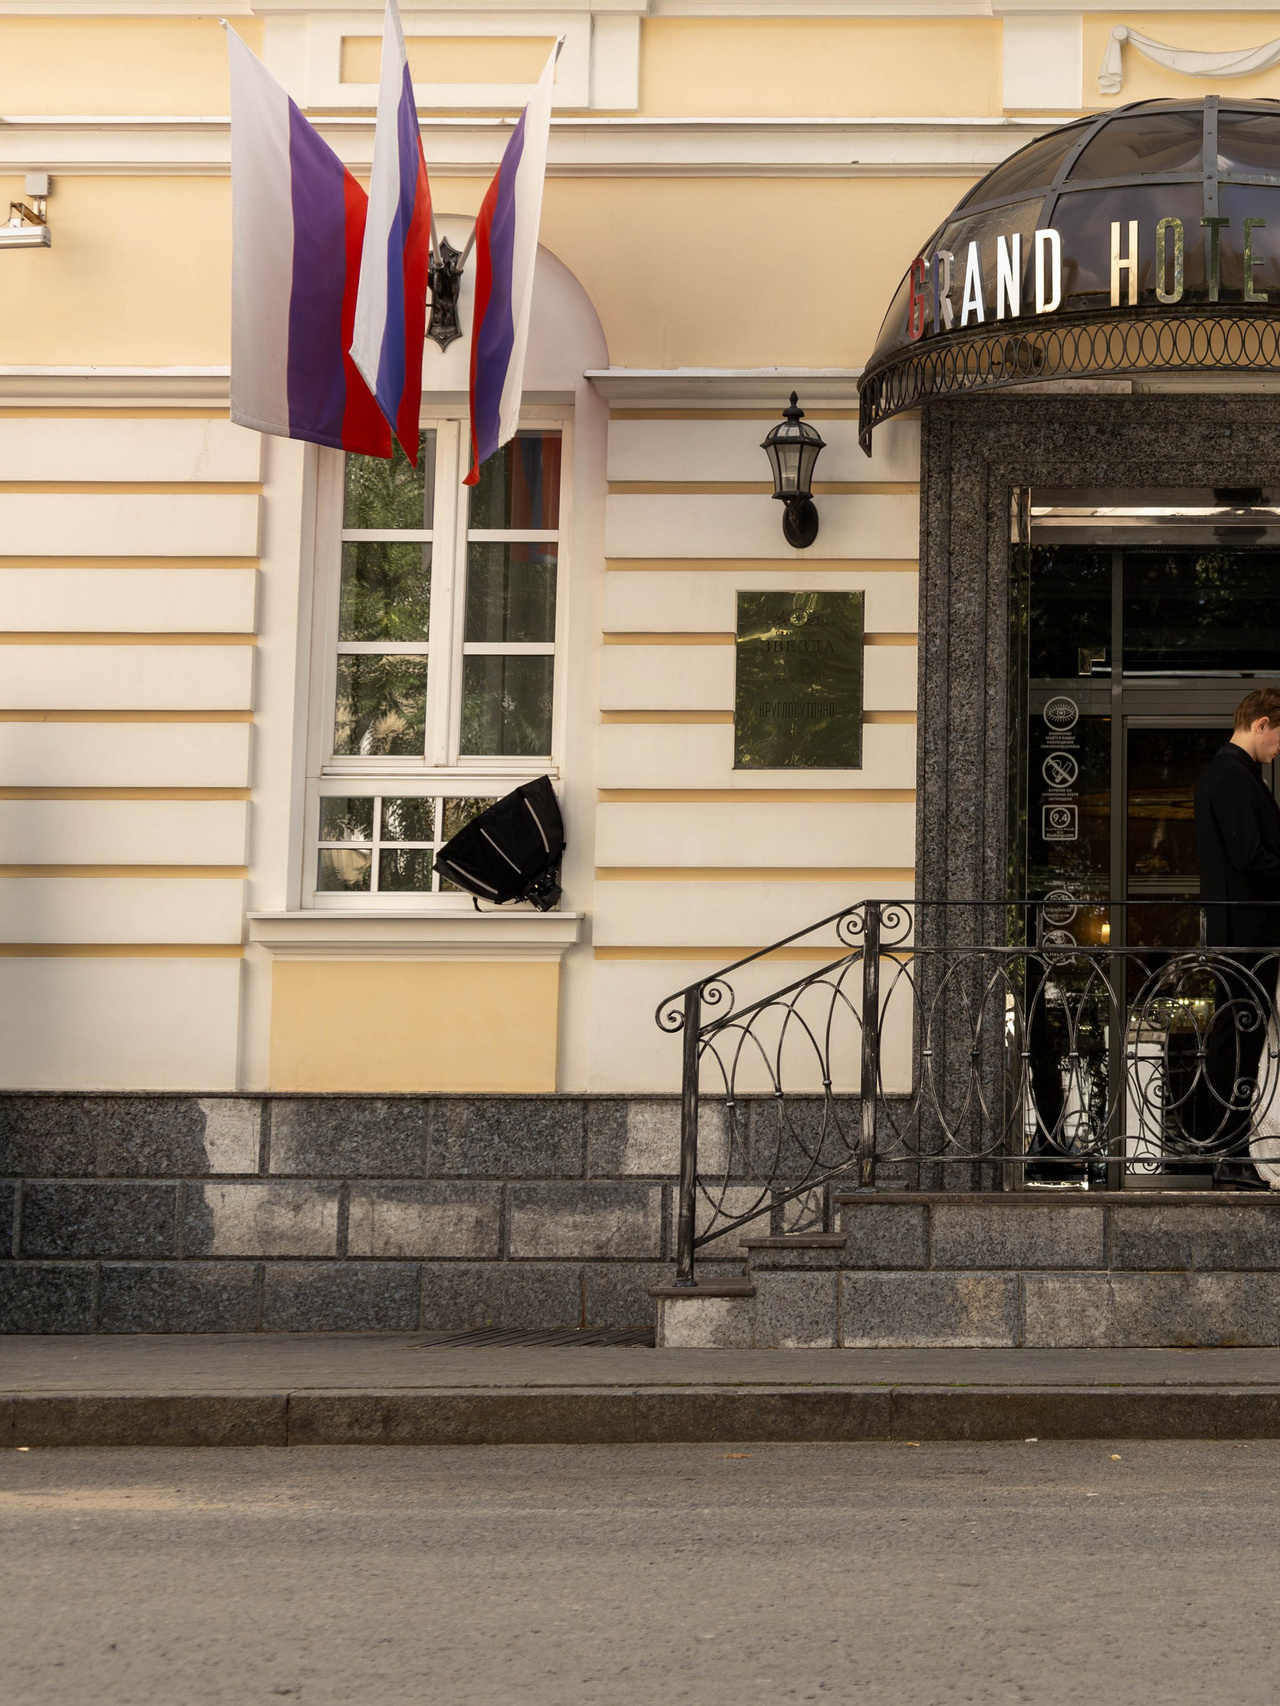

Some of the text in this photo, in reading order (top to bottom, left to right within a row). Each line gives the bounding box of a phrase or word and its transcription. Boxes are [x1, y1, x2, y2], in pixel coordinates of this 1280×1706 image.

[909, 227, 1062, 341] GRAND
[760, 640, 835, 653] ЗВЕЗДА
[760, 702, 834, 718] КРУГЛОСУТОЧНО
[1052, 813, 1068, 823] 9.4
